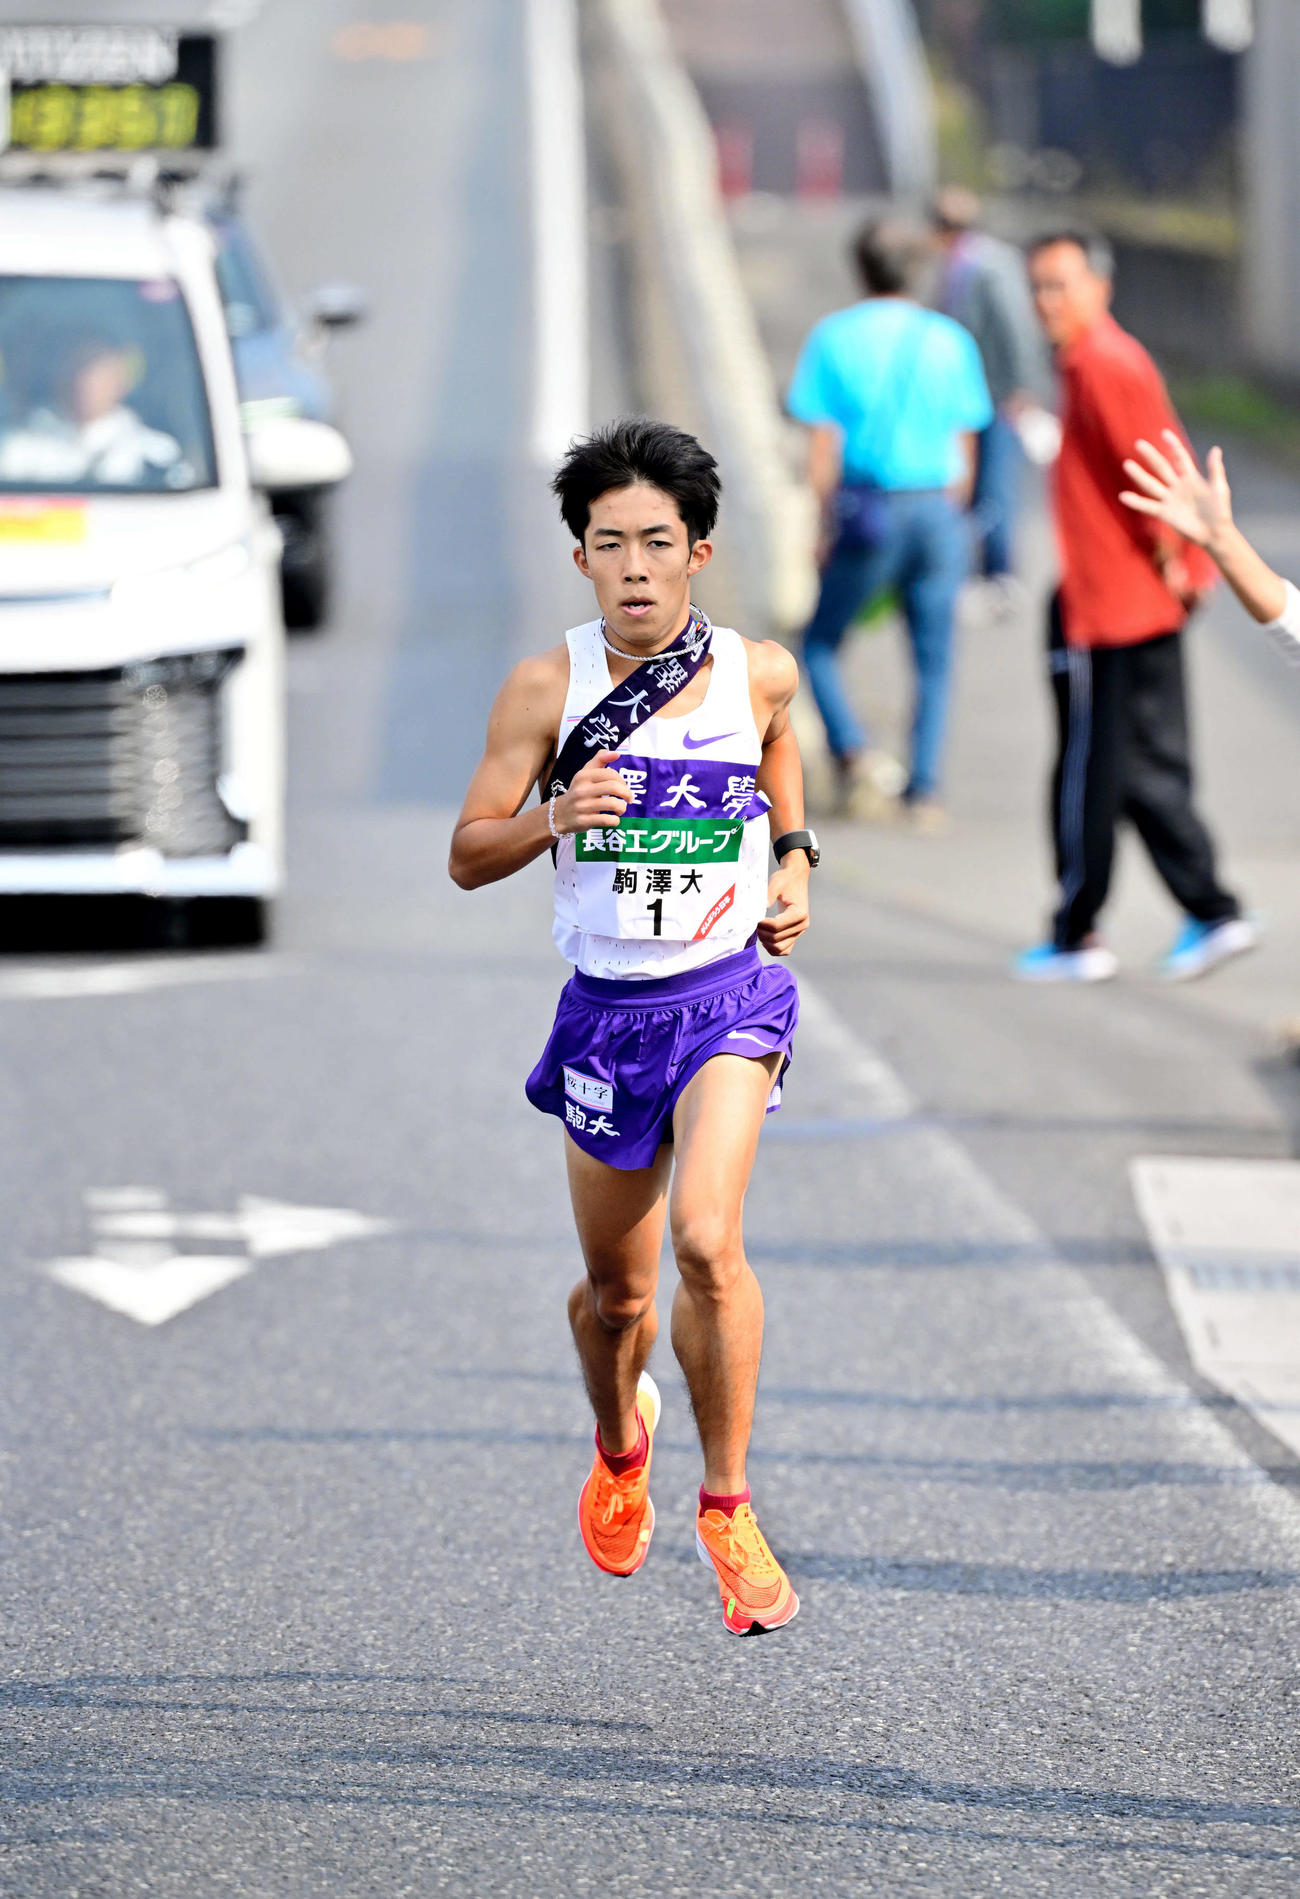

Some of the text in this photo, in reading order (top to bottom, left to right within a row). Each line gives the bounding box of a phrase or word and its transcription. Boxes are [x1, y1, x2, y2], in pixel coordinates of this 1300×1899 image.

[582, 828, 738, 854] 長谷工グループ
[612, 868, 703, 895] 駒澤大
[646, 898, 663, 936] 1
[565, 1100, 620, 1137] 駒大
